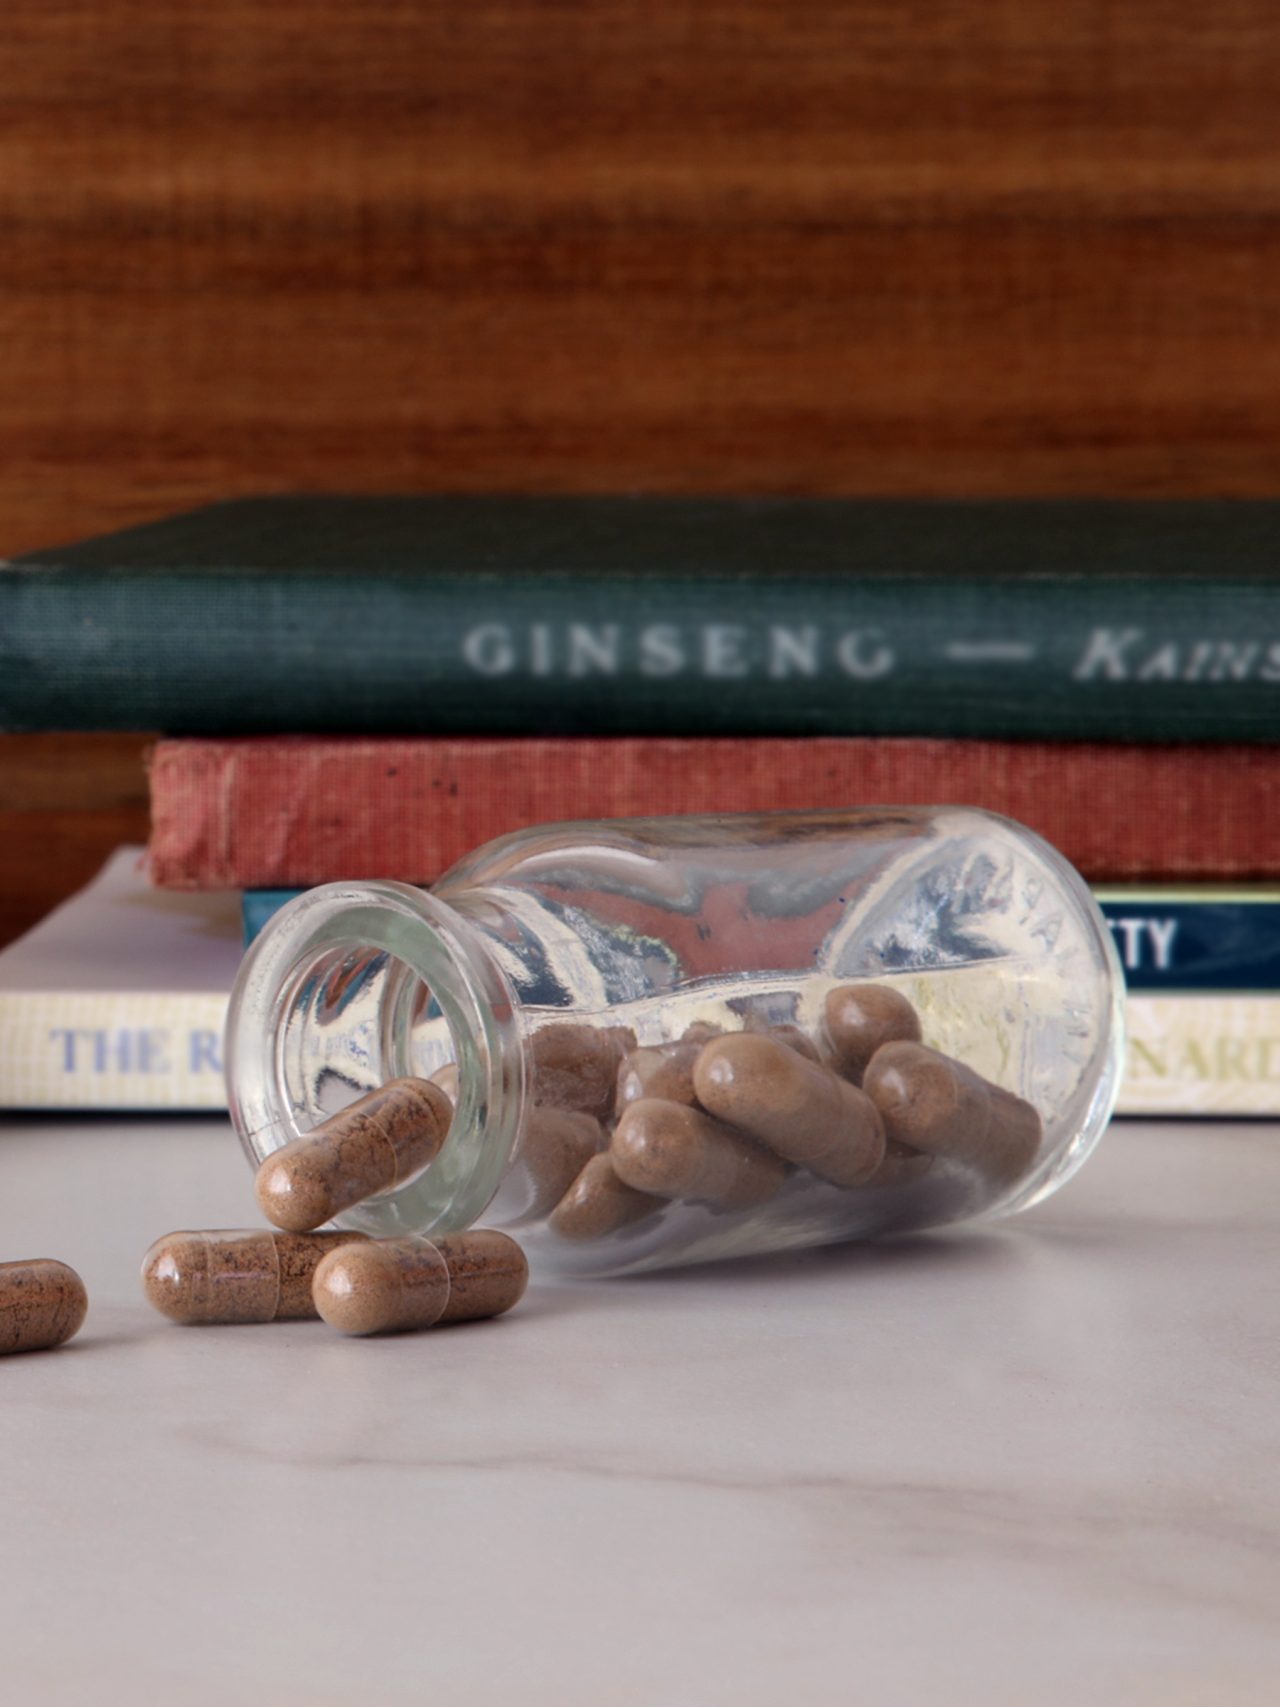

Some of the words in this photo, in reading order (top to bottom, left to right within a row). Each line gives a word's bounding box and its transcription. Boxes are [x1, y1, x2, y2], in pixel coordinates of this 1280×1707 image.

[463, 622, 895, 679] GINSENG
[1107, 918, 1178, 970] TY
[49, 1029, 172, 1074] THE
